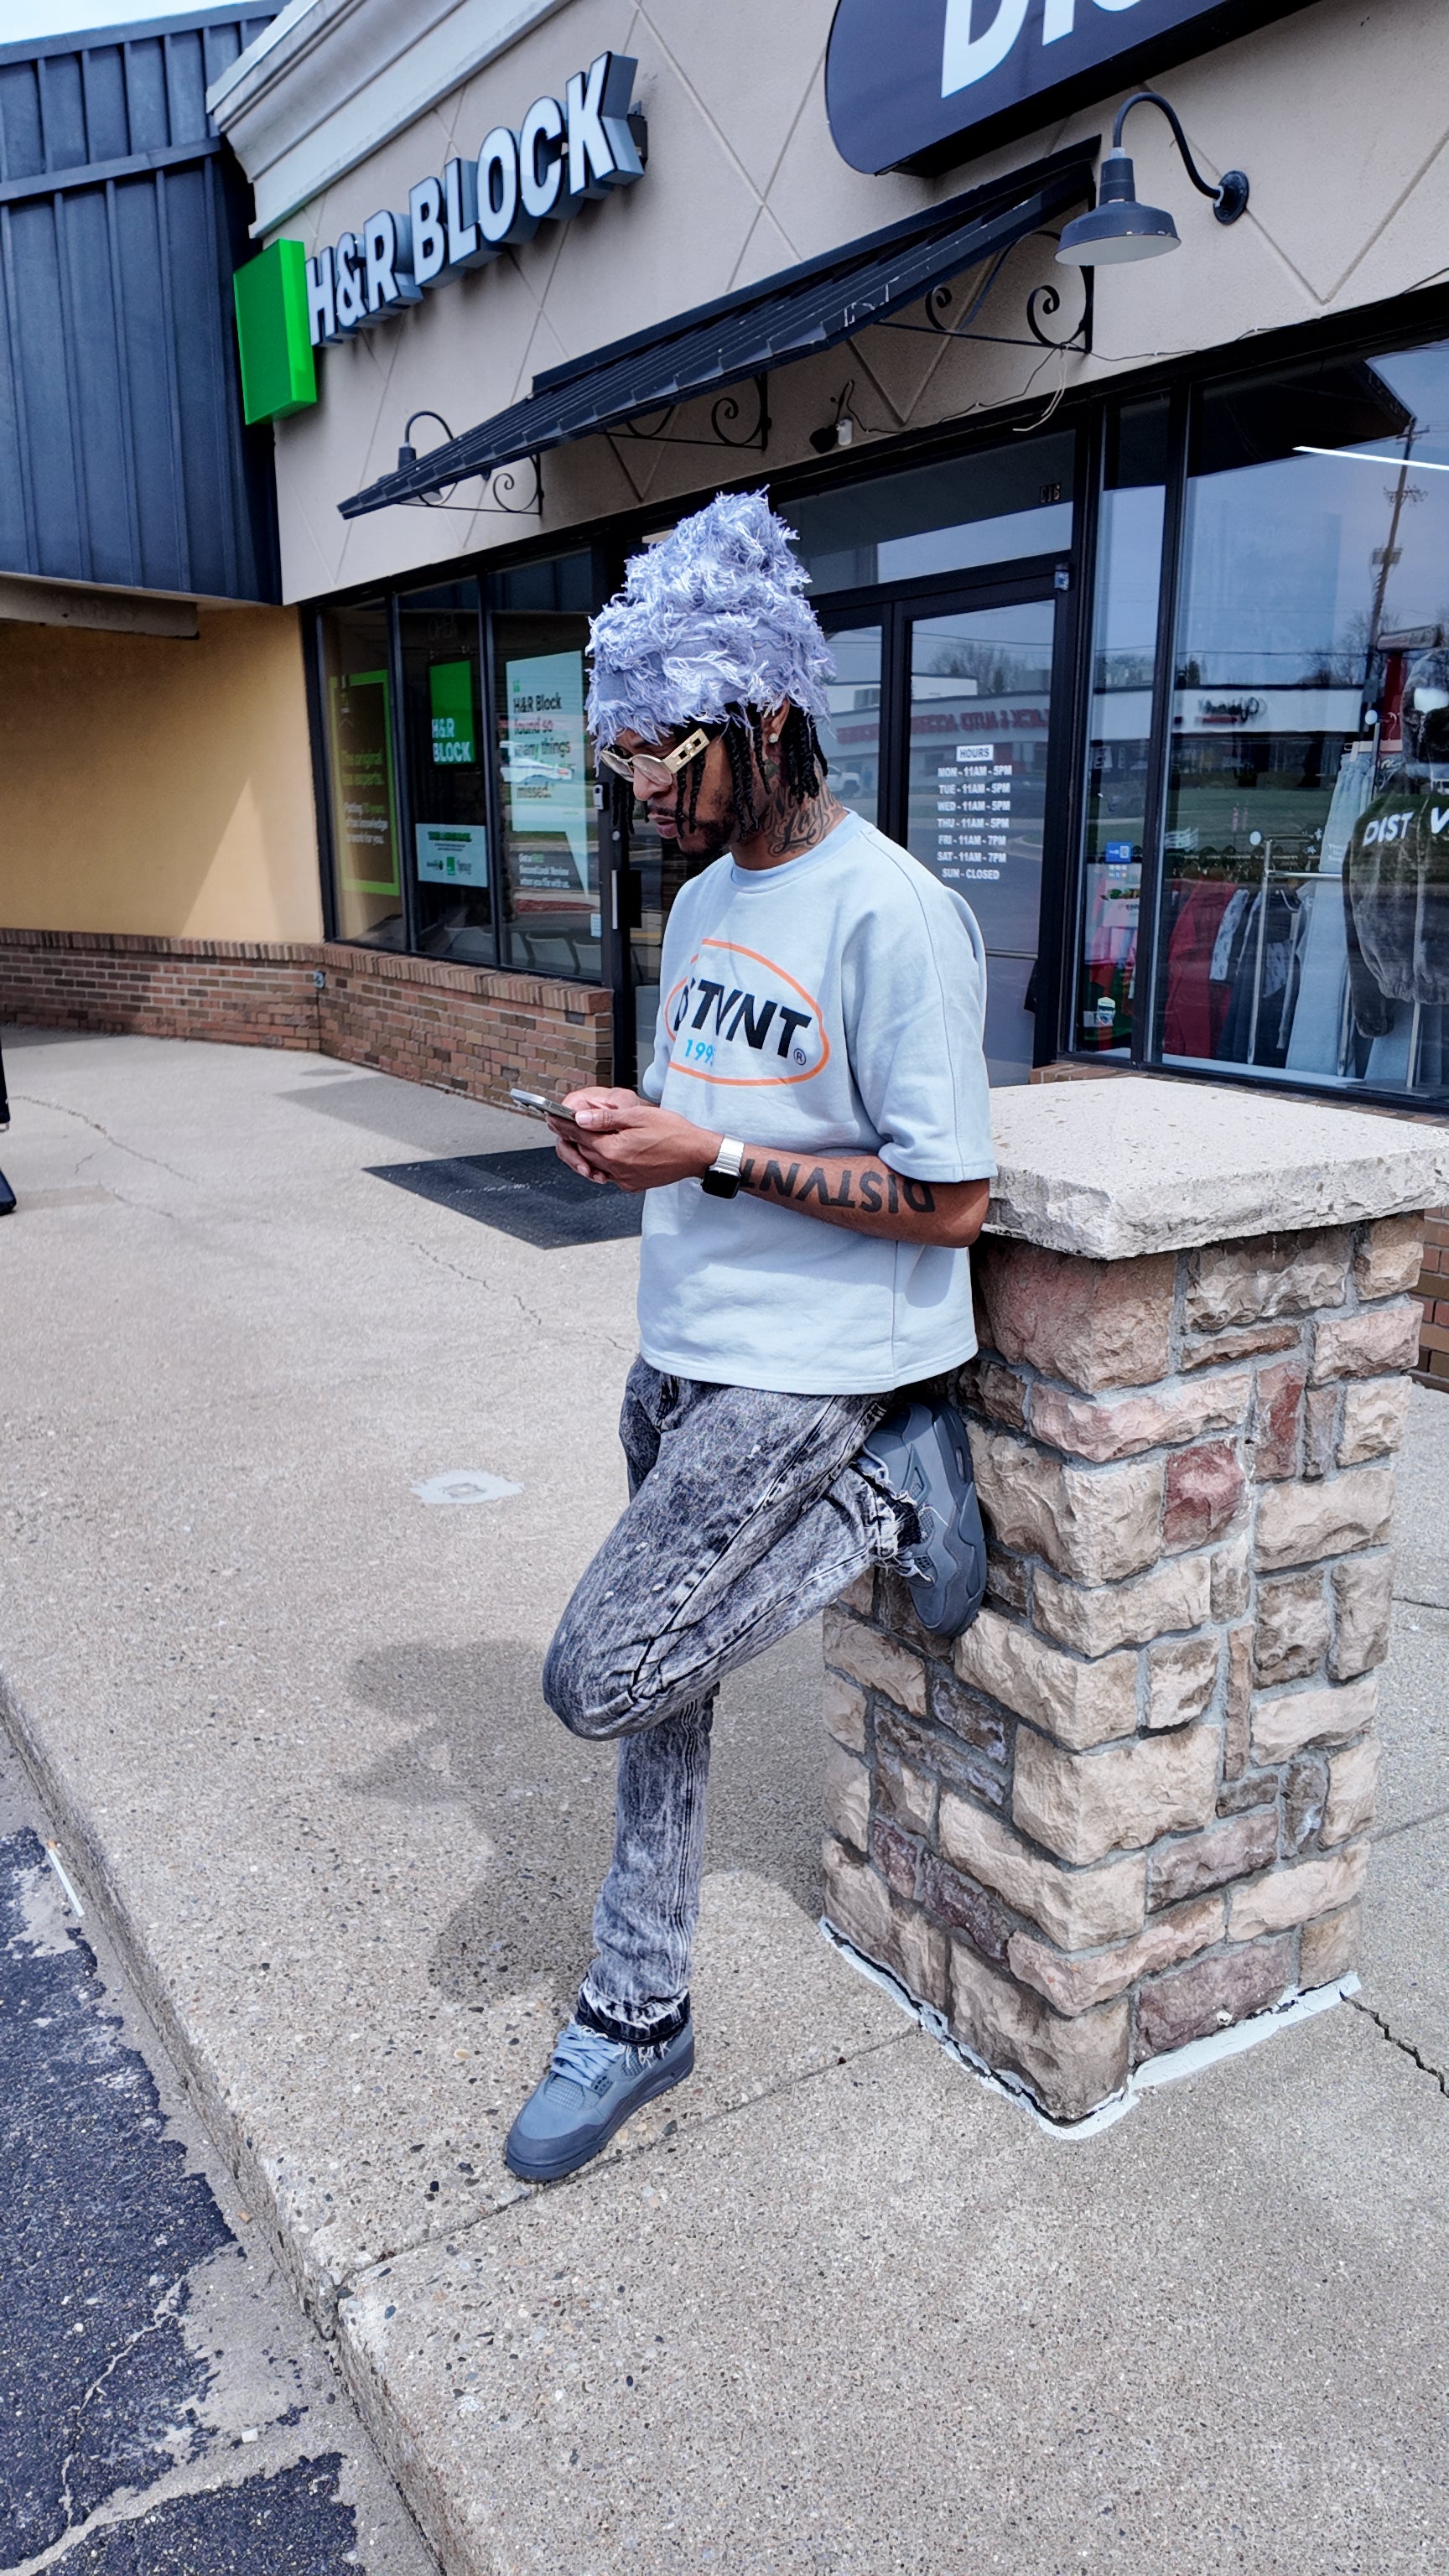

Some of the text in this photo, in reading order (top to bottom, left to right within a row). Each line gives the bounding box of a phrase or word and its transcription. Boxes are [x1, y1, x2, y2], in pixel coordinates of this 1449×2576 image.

[305, 50, 618, 346] H&R BLOCK
[513, 692, 562, 714] H&R Block
[431, 718, 454, 738] H&R
[514, 717, 554, 735] found so
[432, 741, 471, 762] BLOCK
[541, 737, 571, 758] things
[959, 747, 990, 759] HOURS
[937, 767, 958, 777] MON
[963, 766, 987, 776] 11AM
[993, 765, 1012, 776] 5PM
[938, 784, 957, 795] TUE
[962, 783, 985, 793] 11AM
[991, 782, 1010, 793] 5PM
[937, 801, 957, 812] WED
[963, 801, 985, 811] 11AM
[991, 801, 1010, 812] 5PM
[937, 818, 955, 828] THU
[961, 818, 985, 828] 11AM
[990, 818, 1010, 828] 5PM
[1362, 811, 1415, 847] DIST
[938, 834, 953, 845] FRI
[958, 834, 982, 845] 11AM
[988, 835, 1006, 846] 7PM
[937, 851, 953, 862] SAT
[959, 852, 982, 862] 11AM
[988, 852, 1007, 863] 7PM
[942, 868, 960, 879] SUN
[965, 869, 1000, 880] CLOSED
[684, 1038, 715, 1067] 199
[740, 1158, 936, 1214] DISTVNT
